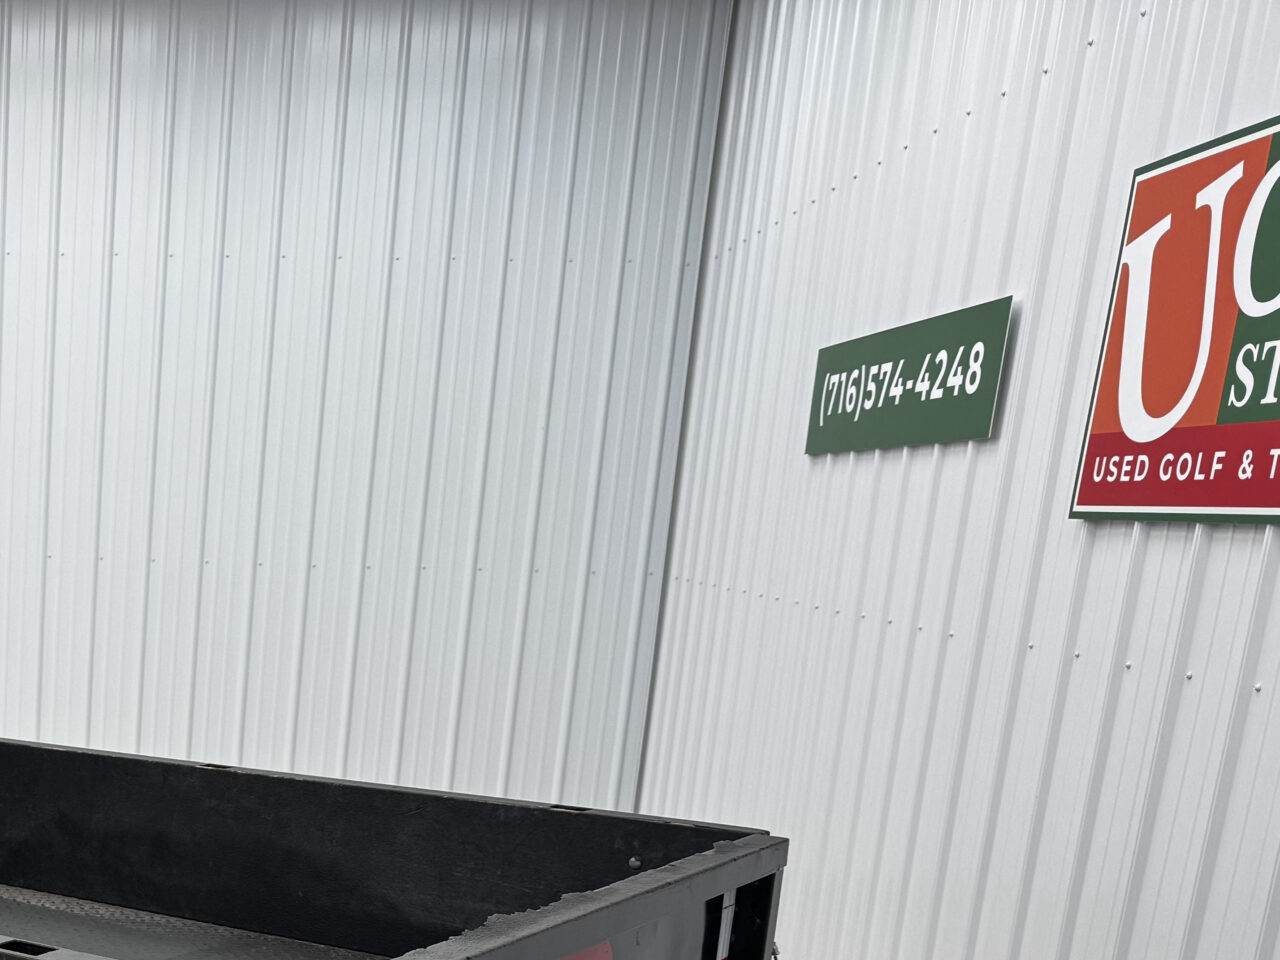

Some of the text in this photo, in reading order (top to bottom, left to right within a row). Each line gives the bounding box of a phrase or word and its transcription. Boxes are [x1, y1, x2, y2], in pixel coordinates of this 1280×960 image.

[820, 342, 985, 427] (716)574-4248
[1093, 454, 1149, 483] USED
[1159, 451, 1226, 482] GOLF
[1238, 449, 1254, 479] &
